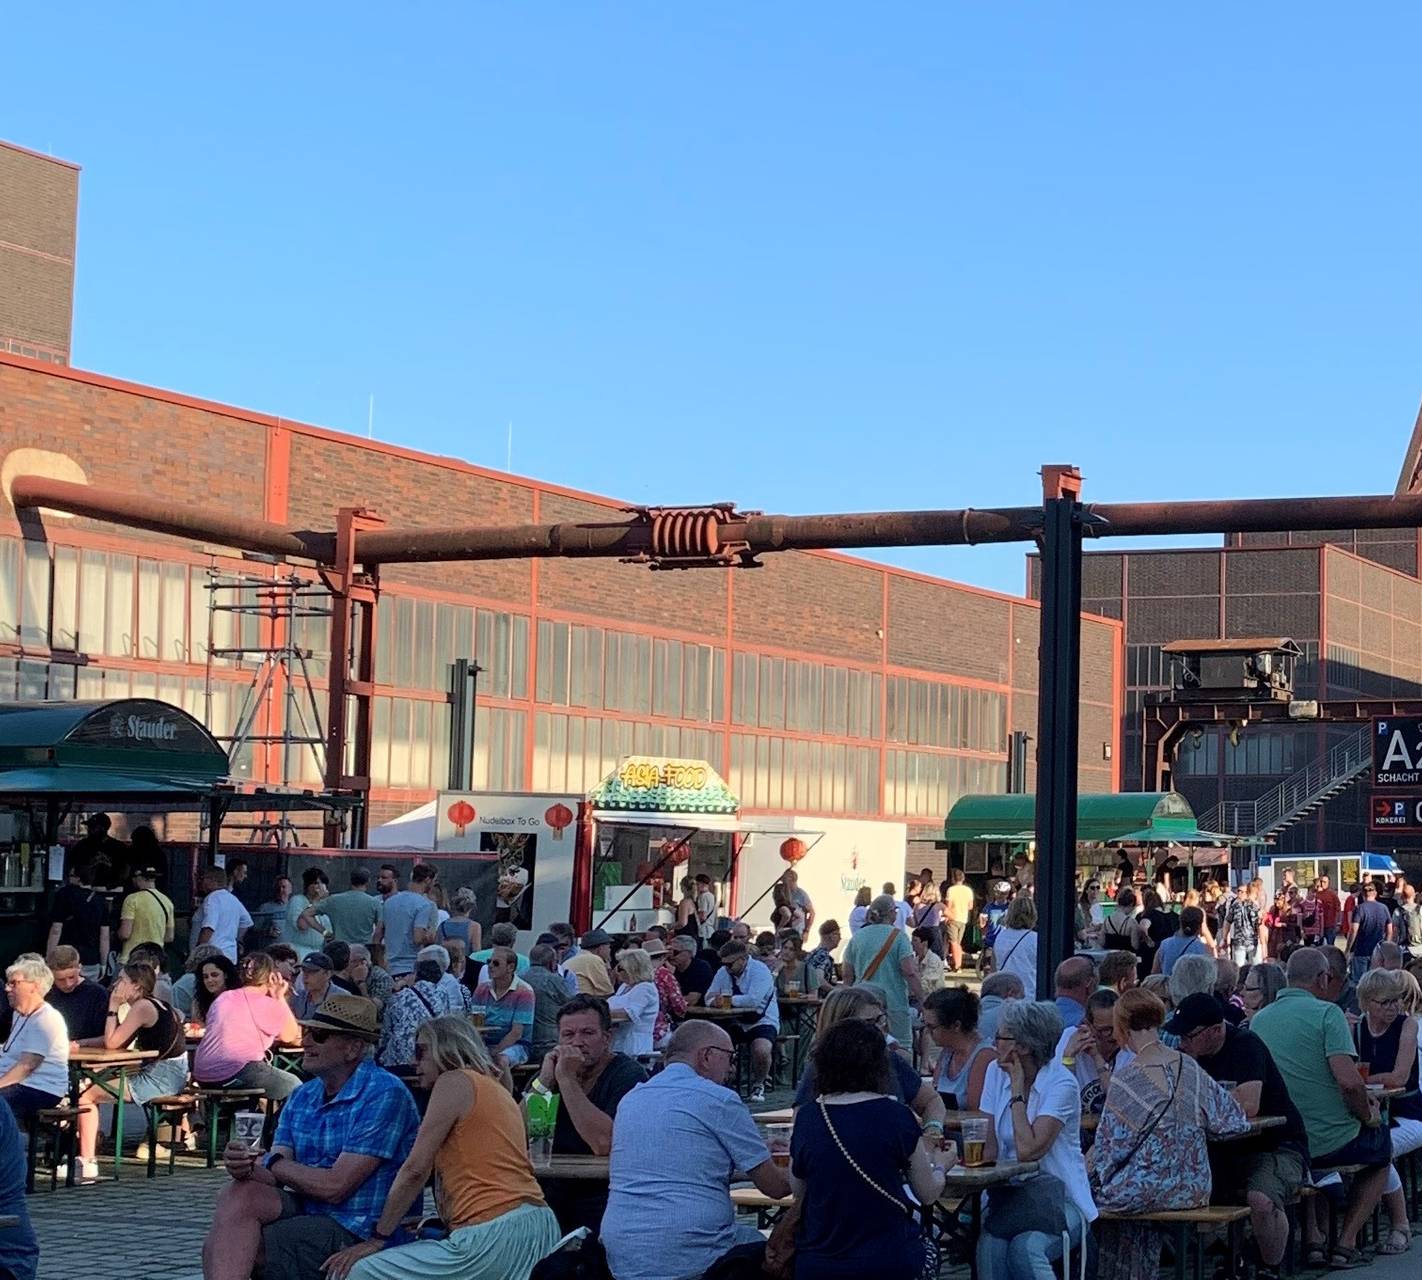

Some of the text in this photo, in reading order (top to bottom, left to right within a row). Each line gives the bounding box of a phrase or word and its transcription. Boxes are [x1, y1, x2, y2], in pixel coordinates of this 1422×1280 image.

[127, 714, 178, 741] Stauder
[1378, 721, 1387, 735] P
[1378, 773, 1420, 782] SCHACHT
[1394, 802, 1404, 816] P
[518, 816, 527, 826] To
[528, 816, 541, 826] Go
